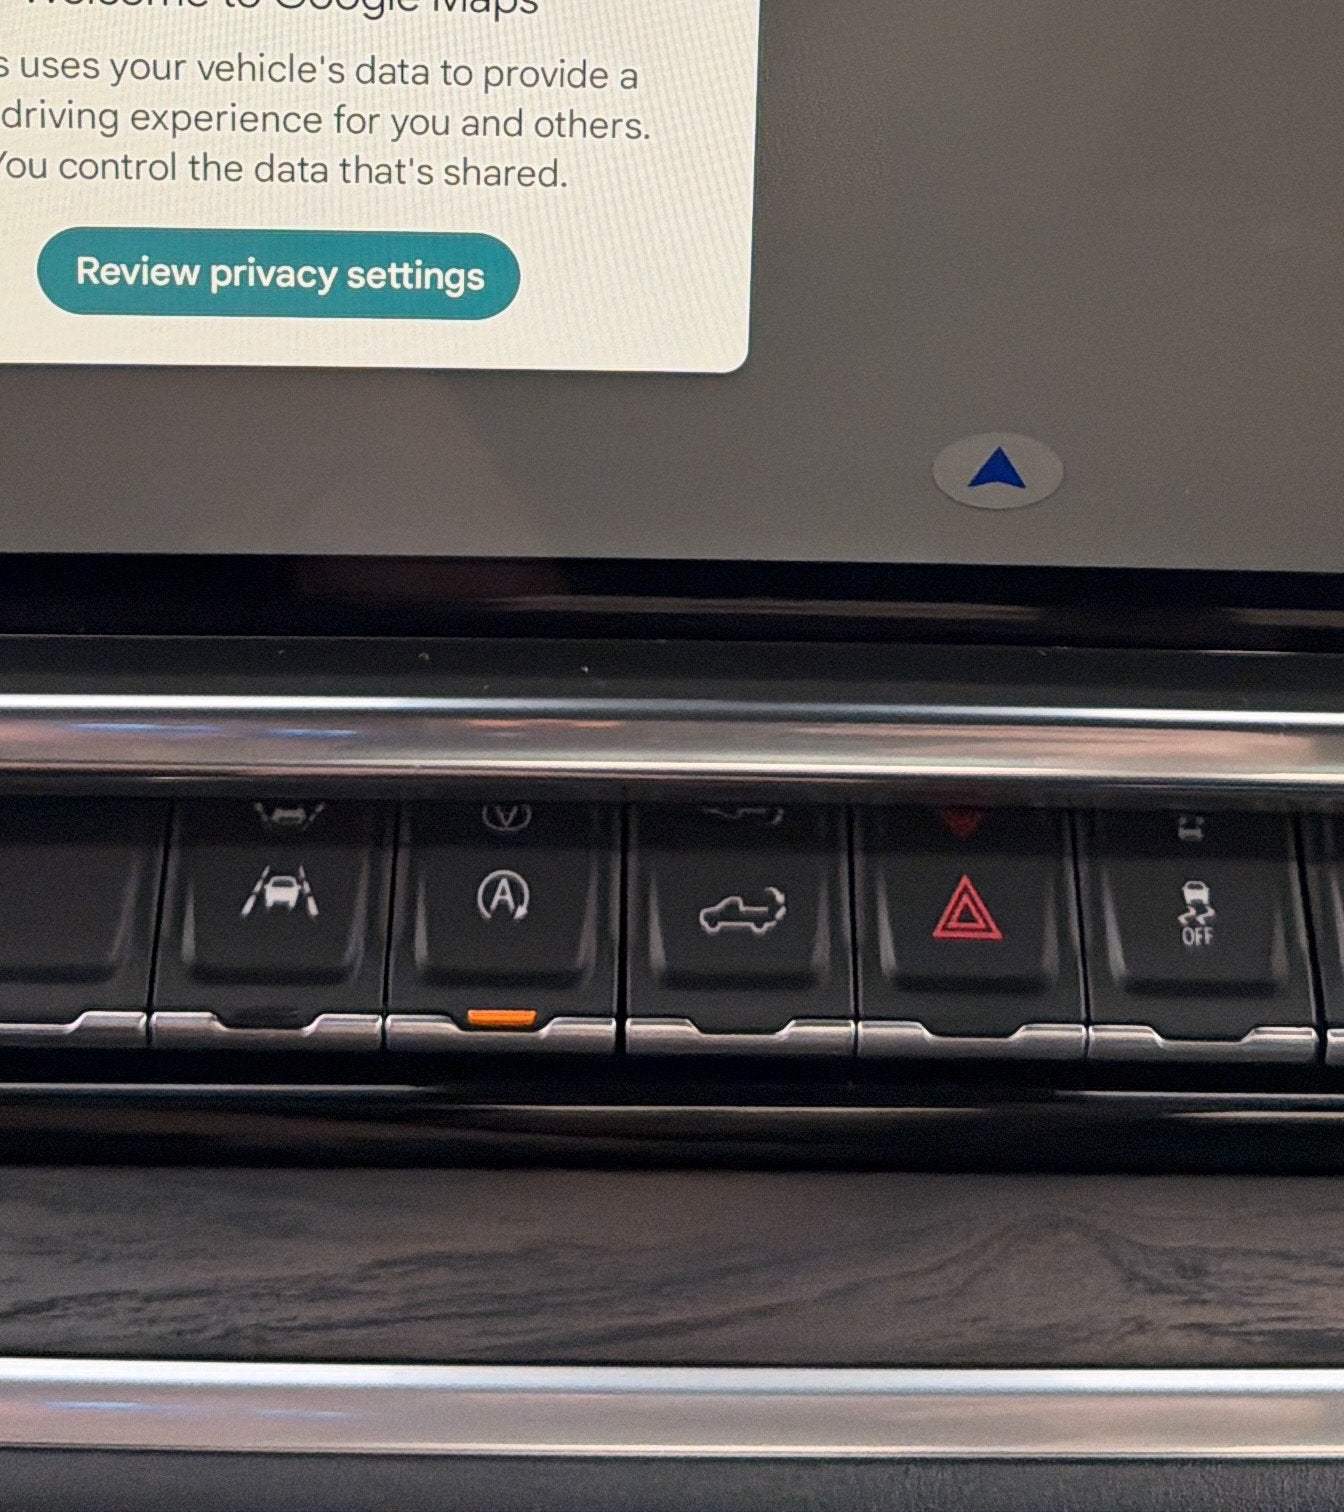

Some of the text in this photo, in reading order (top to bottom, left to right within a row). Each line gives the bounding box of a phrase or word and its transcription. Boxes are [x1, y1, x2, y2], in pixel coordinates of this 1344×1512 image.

[20, 56, 100, 80] uses
[109, 58, 187, 88] your
[197, 51, 346, 85] vehicle's
[355, 54, 430, 86] data
[440, 59, 474, 87] to
[483, 58, 609, 93] provide
[620, 68, 638, 90] a
[1, 98, 119, 139] driving
[130, 101, 323, 139] experience
[333, 103, 381, 135] for
[390, 113, 450, 143] you
[461, 107, 523, 138] and
[534, 108, 650, 140] others.
[58, 150, 177, 182] control
[188, 151, 244, 183] the
[254, 152, 329, 184] data
[339, 154, 434, 186] that's
[443, 156, 567, 188] shared.
[77, 254, 485, 298] Review privacy settings
[1180, 924, 1214, 947] OFF
